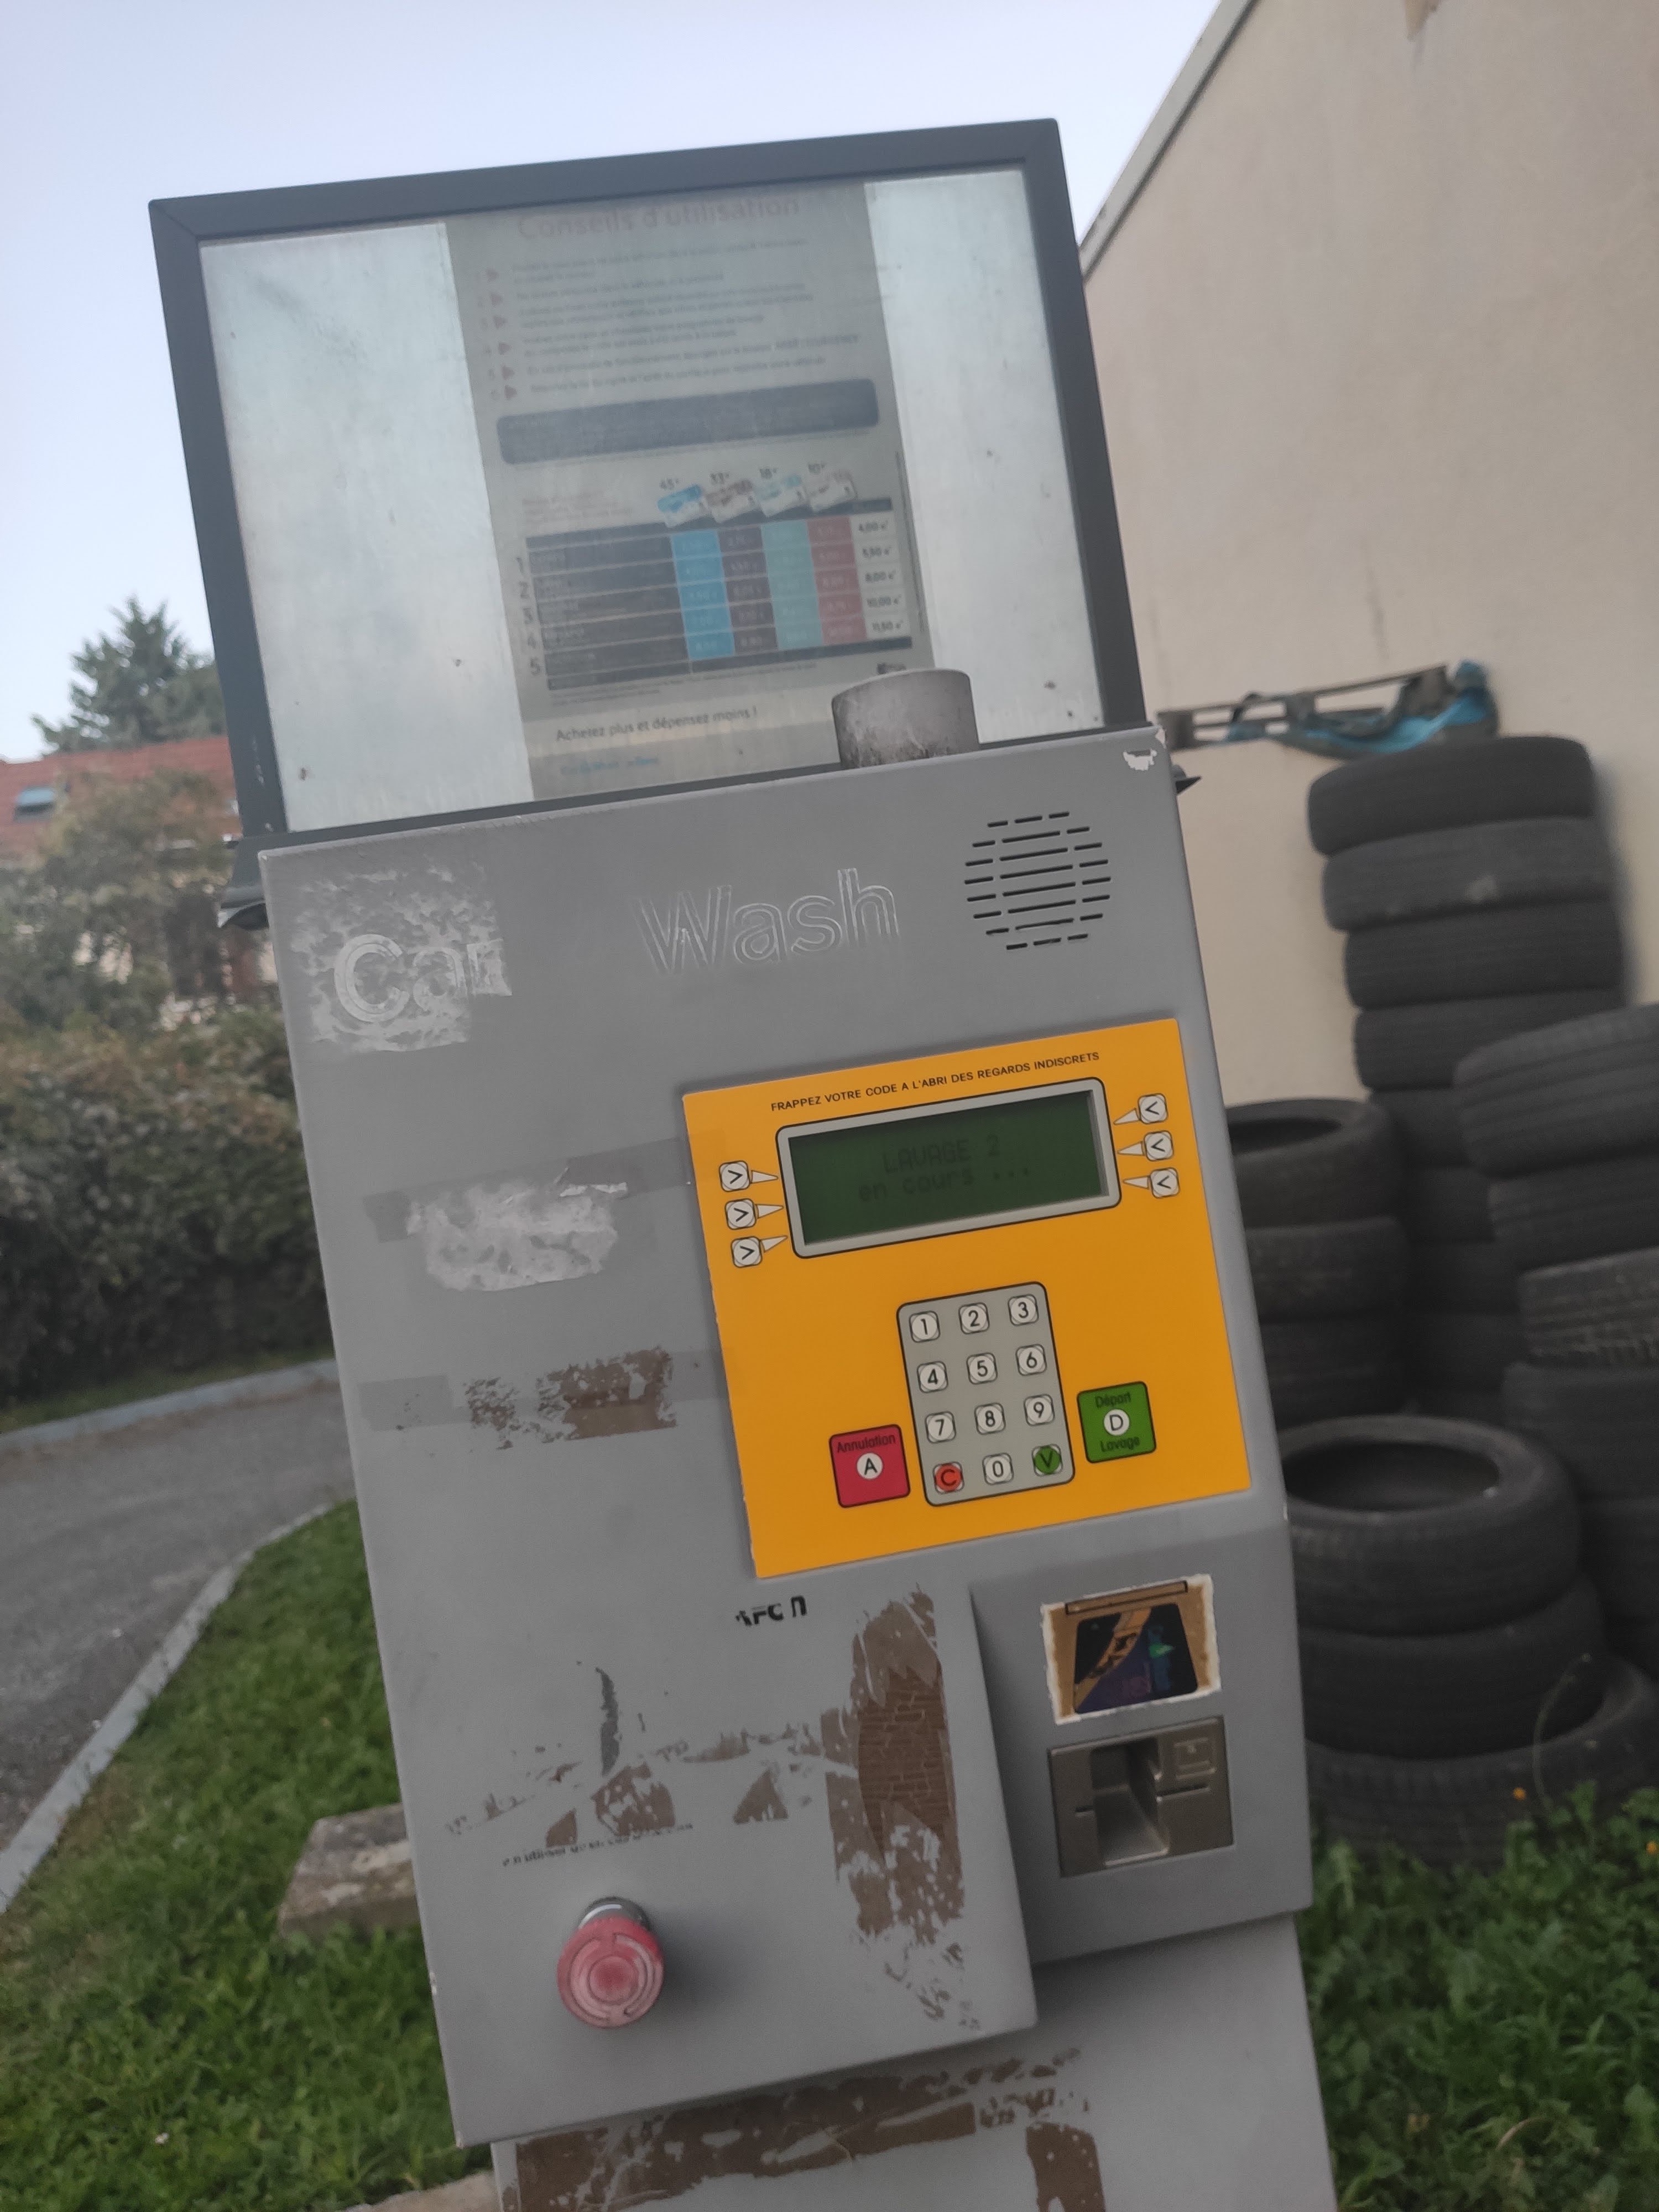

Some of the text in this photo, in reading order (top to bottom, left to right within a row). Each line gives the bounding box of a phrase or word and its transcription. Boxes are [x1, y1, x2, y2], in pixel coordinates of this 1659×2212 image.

[530, 658, 540, 675] 5
[556, 723, 604, 742] Achetez
[609, 719, 635, 735] plus
[637, 717, 649, 730] et
[712, 709, 750, 722] moins
[630, 868, 900, 974] Wash
[771, 1051, 1099, 1112] FRAPPEZ VOTRE CODE A L'ABRI DES REGARDS INDISCRETS
[882, 1134, 1000, 1173] LAVAGE 2
[859, 1183, 886, 1202] en
[901, 1171, 974, 1196] cours
[968, 1310, 979, 1327] 2
[1018, 1302, 1029, 1319] 3
[921, 1318, 928, 1335] 1
[977, 1360, 988, 1377] 5
[1026, 1352, 1037, 1369] 6
[927, 1369, 938, 1386] 4
[1095, 1391, 1131, 1408] Départ
[985, 1410, 995, 1427] 8
[1034, 1402, 1045, 1418] 9
[935, 1419, 945, 1436] 7
[1110, 1413, 1124, 1431] D
[836, 1433, 896, 1453] Annulation
[1100, 1436, 1141, 1452] Lavage
[863, 1458, 878, 1475] A
[1040, 1452, 1053, 1468] V
[940, 1469, 957, 1486] C
[993, 1460, 1003, 1478] 0
